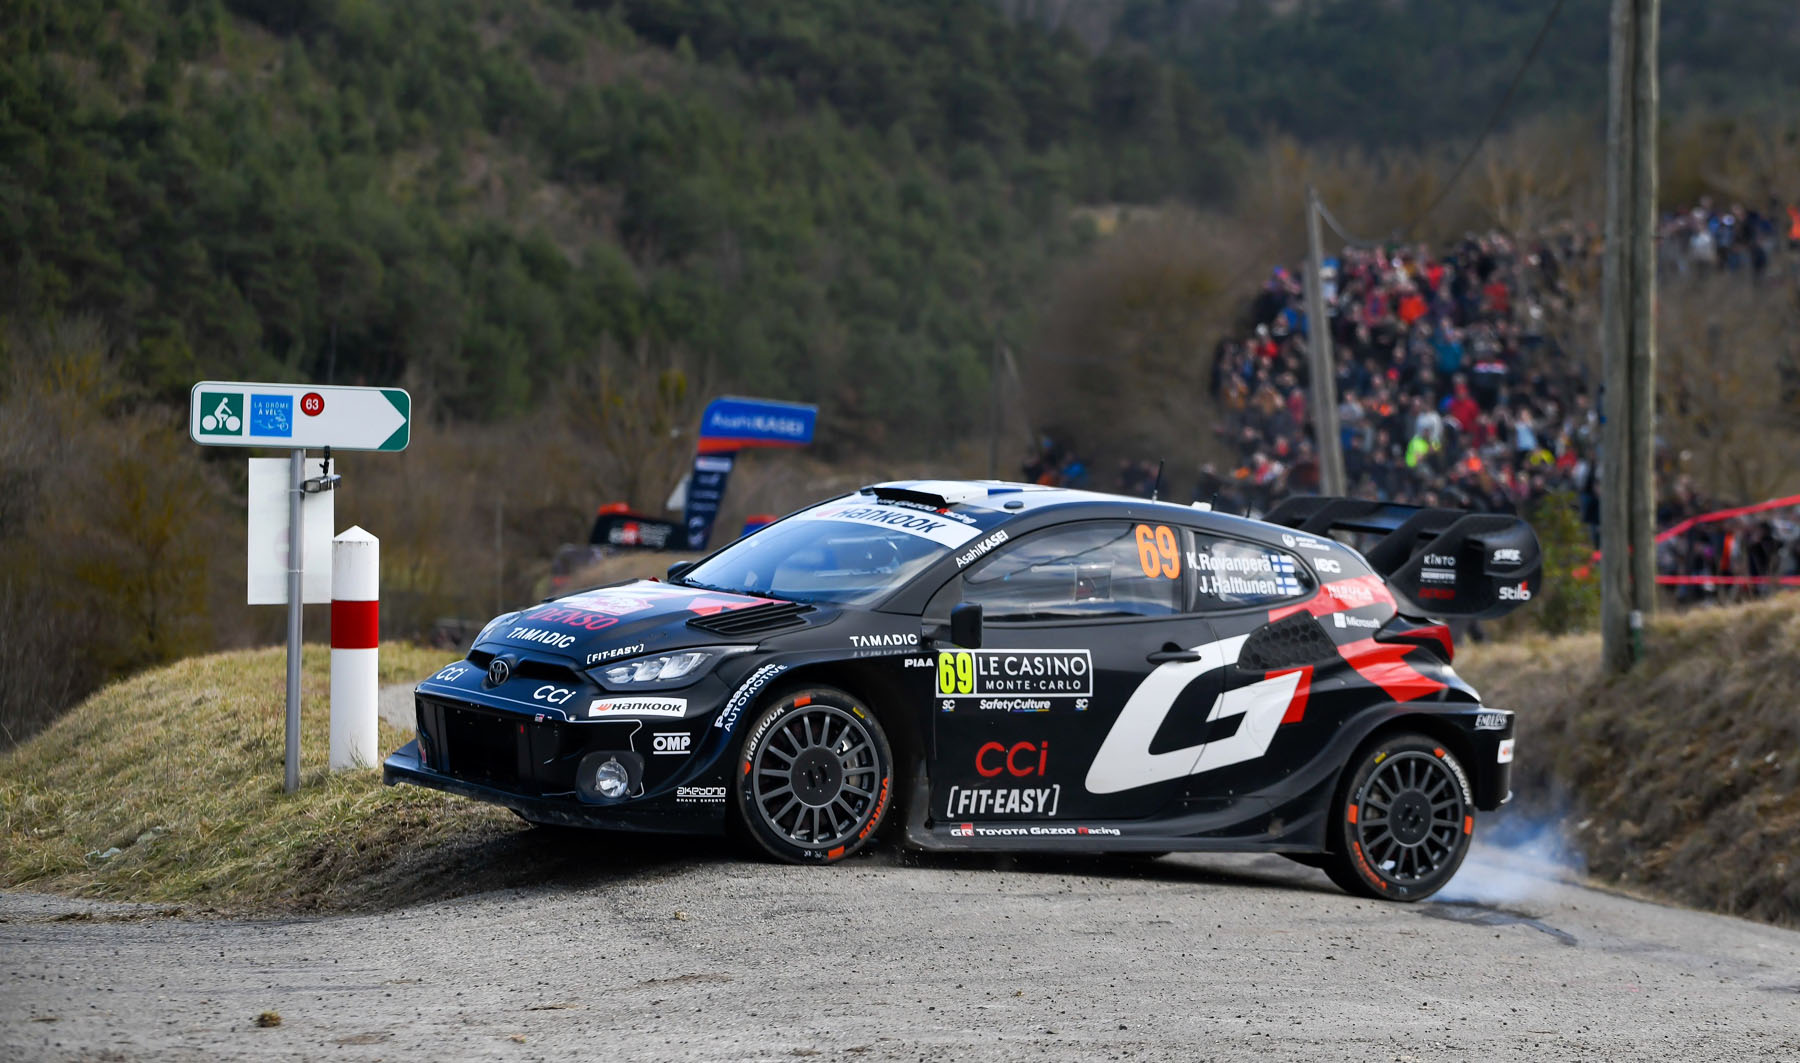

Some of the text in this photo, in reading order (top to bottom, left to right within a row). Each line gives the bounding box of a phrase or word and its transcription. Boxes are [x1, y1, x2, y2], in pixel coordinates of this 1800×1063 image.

[306, 398, 319, 411] 63
[955, 530, 1009, 568] AsahiKASEI
[1135, 524, 1181, 580] 69
[1498, 581, 1531, 600] Stilo
[526, 608, 620, 631] DENSO
[1345, 615, 1380, 629] Microsoft
[506, 627, 576, 649] TAMADIC
[850, 633, 918, 648] TAMADIC
[904, 658, 935, 668] PIAA
[978, 656, 1087, 676] LE CASINO
[938, 652, 973, 694] 69
[714, 663, 776, 728] Panasonic
[724, 664, 788, 732] AUTOMOTIVE
[1075, 698, 1089, 709] SC
[942, 699, 956, 710] SC
[979, 698, 1052, 712] SafetyCulture
[653, 736, 691, 751] OMP
[976, 827, 1028, 836] TOYOTA
[1030, 826, 1076, 835] GAZOO
[1077, 826, 1121, 837] Racing
